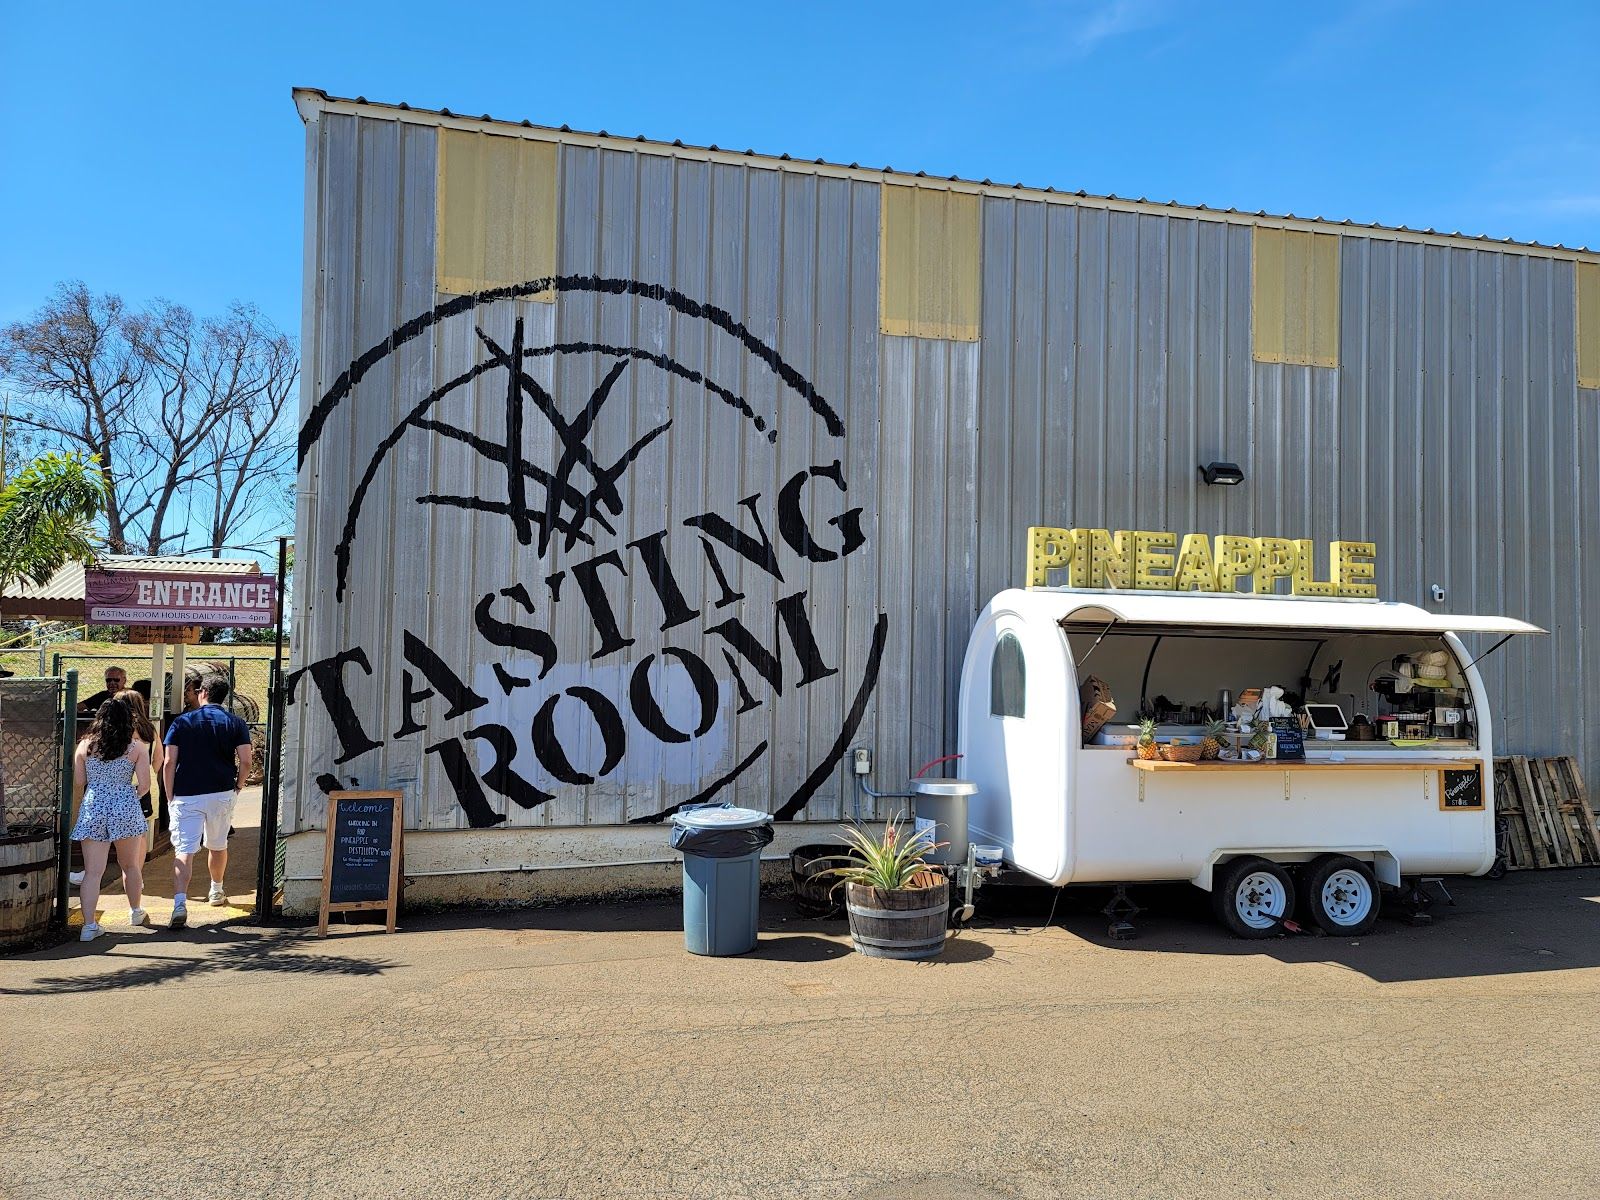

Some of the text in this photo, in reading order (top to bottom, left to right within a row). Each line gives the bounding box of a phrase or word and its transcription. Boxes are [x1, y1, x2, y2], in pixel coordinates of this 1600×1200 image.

[1027, 527, 1376, 598] PINEAPPLE
[97, 610, 130, 618] TASTING
[133, 611, 159, 619] ROOM
[192, 612, 215, 620] DAILY
[137, 580, 270, 608] ENTRANCE
[287, 459, 866, 764] TASTING
[425, 590, 838, 828] ROOM
[340, 836, 369, 844] PINEAPPLE
